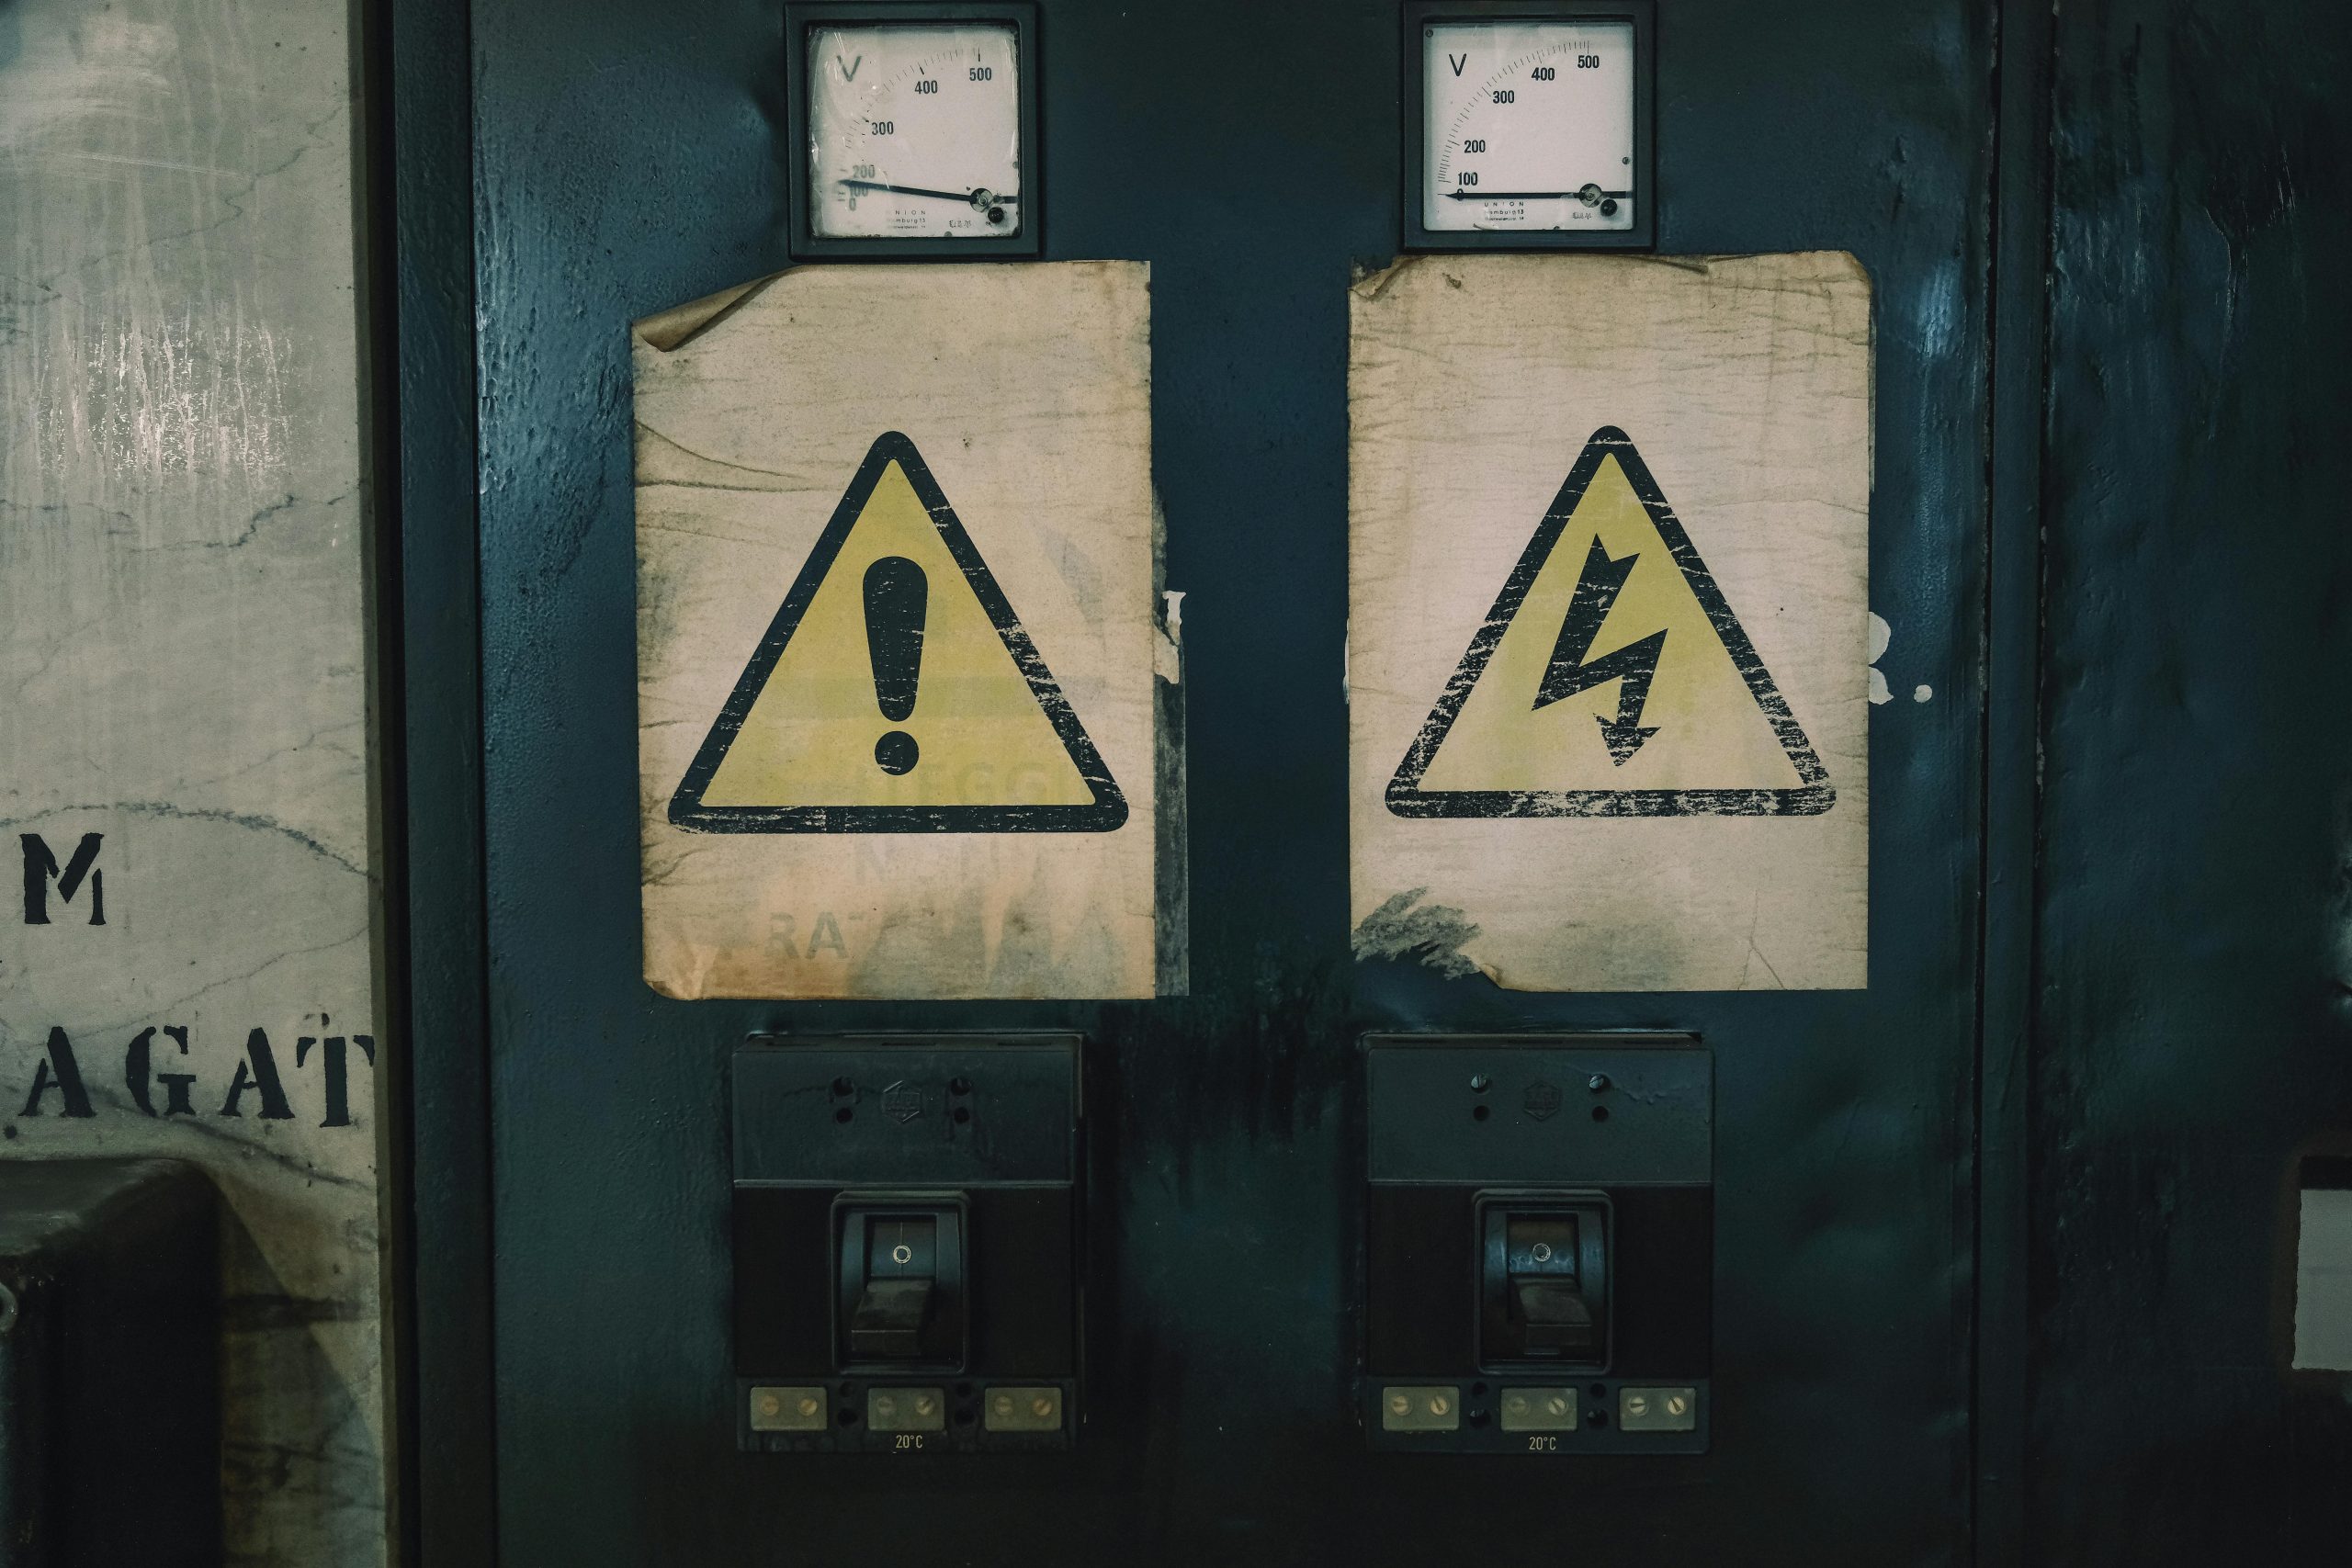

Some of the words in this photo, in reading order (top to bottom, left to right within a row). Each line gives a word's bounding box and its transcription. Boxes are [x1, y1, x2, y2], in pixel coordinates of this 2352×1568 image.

[836, 55, 862, 82] V
[1449, 53, 1467, 76] V
[1577, 55, 1600, 69] 500
[969, 67, 992, 81] 500
[1532, 67, 1555, 81] 400
[914, 80, 938, 95] 400
[1493, 90, 1515, 104] 300
[871, 121, 894, 135] 300
[1464, 140, 1486, 152] 200
[852, 164, 876, 178] 200
[1457, 172, 1478, 186] 100
[849, 198, 856, 210] 0
[19, 832, 107, 926] M
[18, 1026, 376, 1128] AGAT
[896, 1434, 923, 1449] 20°C
[1529, 1436, 1556, 1450] 20°C
